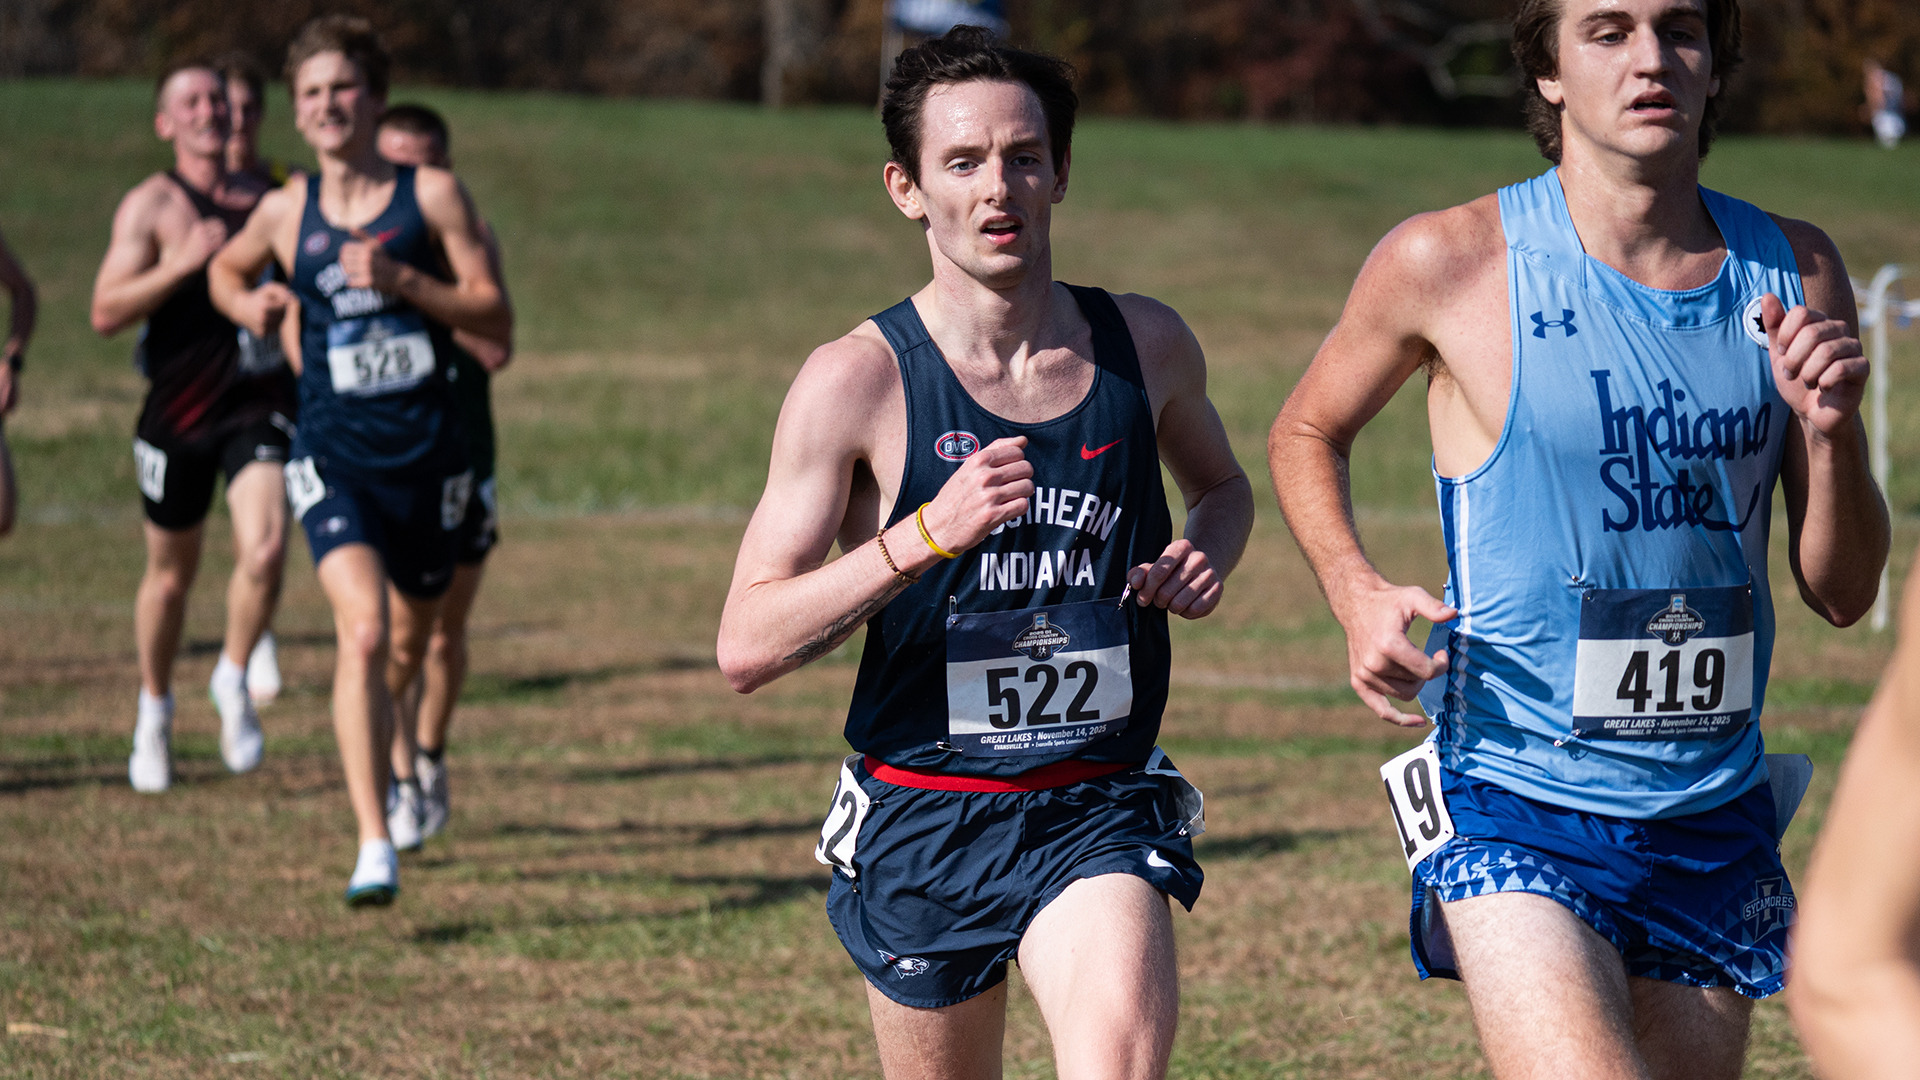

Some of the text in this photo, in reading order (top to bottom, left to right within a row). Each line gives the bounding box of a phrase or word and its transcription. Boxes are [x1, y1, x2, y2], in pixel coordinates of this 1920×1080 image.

[354, 344, 413, 386] 528
[1590, 369, 1772, 460] Indiana
[944, 440, 971, 454] OVC
[984, 486, 1122, 542] HERN
[1600, 455, 1761, 532] State
[979, 548, 1096, 591] INDIANA
[1014, 636, 1068, 648] CHAMPIONSHIPS
[1648, 621, 1704, 631] CHAMPIONSHIPS
[986, 660, 1100, 730] 522
[1616, 648, 1726, 713] 419
[980, 734, 1006, 745] GREAT
[1007, 732, 1033, 743] LAKES
[1037, 729, 1075, 741] November
[1075, 727, 1088, 738] 14,
[1089, 724, 1107, 736] 2025
[1603, 715, 1731, 729] GREAT LAKES November 14, 2025
[819, 777, 857, 866] 2
[1384, 757, 1441, 860] 19
[1745, 895, 1794, 918] SYCAMORES
